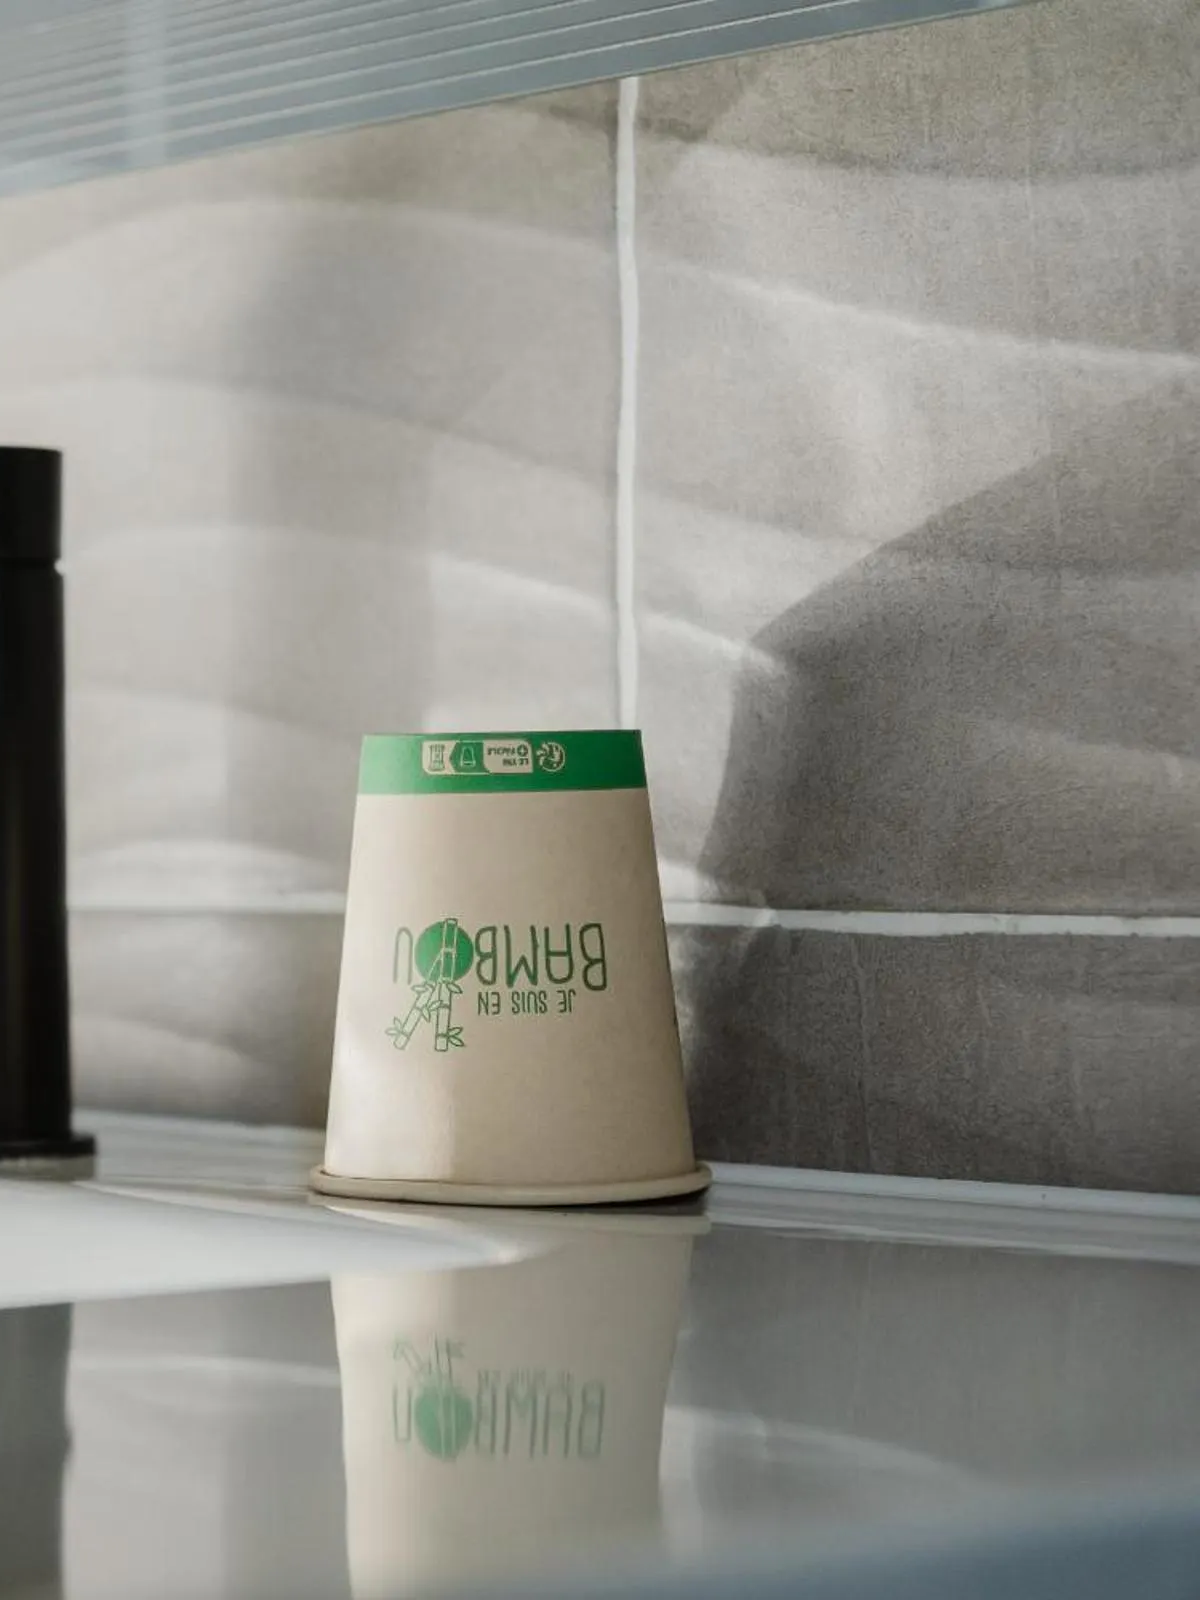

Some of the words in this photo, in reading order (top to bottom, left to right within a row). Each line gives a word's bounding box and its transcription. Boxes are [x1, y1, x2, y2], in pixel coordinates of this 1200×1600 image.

[393, 919, 608, 992] BAMBOU
[477, 990, 501, 1016] EN
[511, 990, 548, 1014] SUIS
[557, 990, 576, 1013] JE
